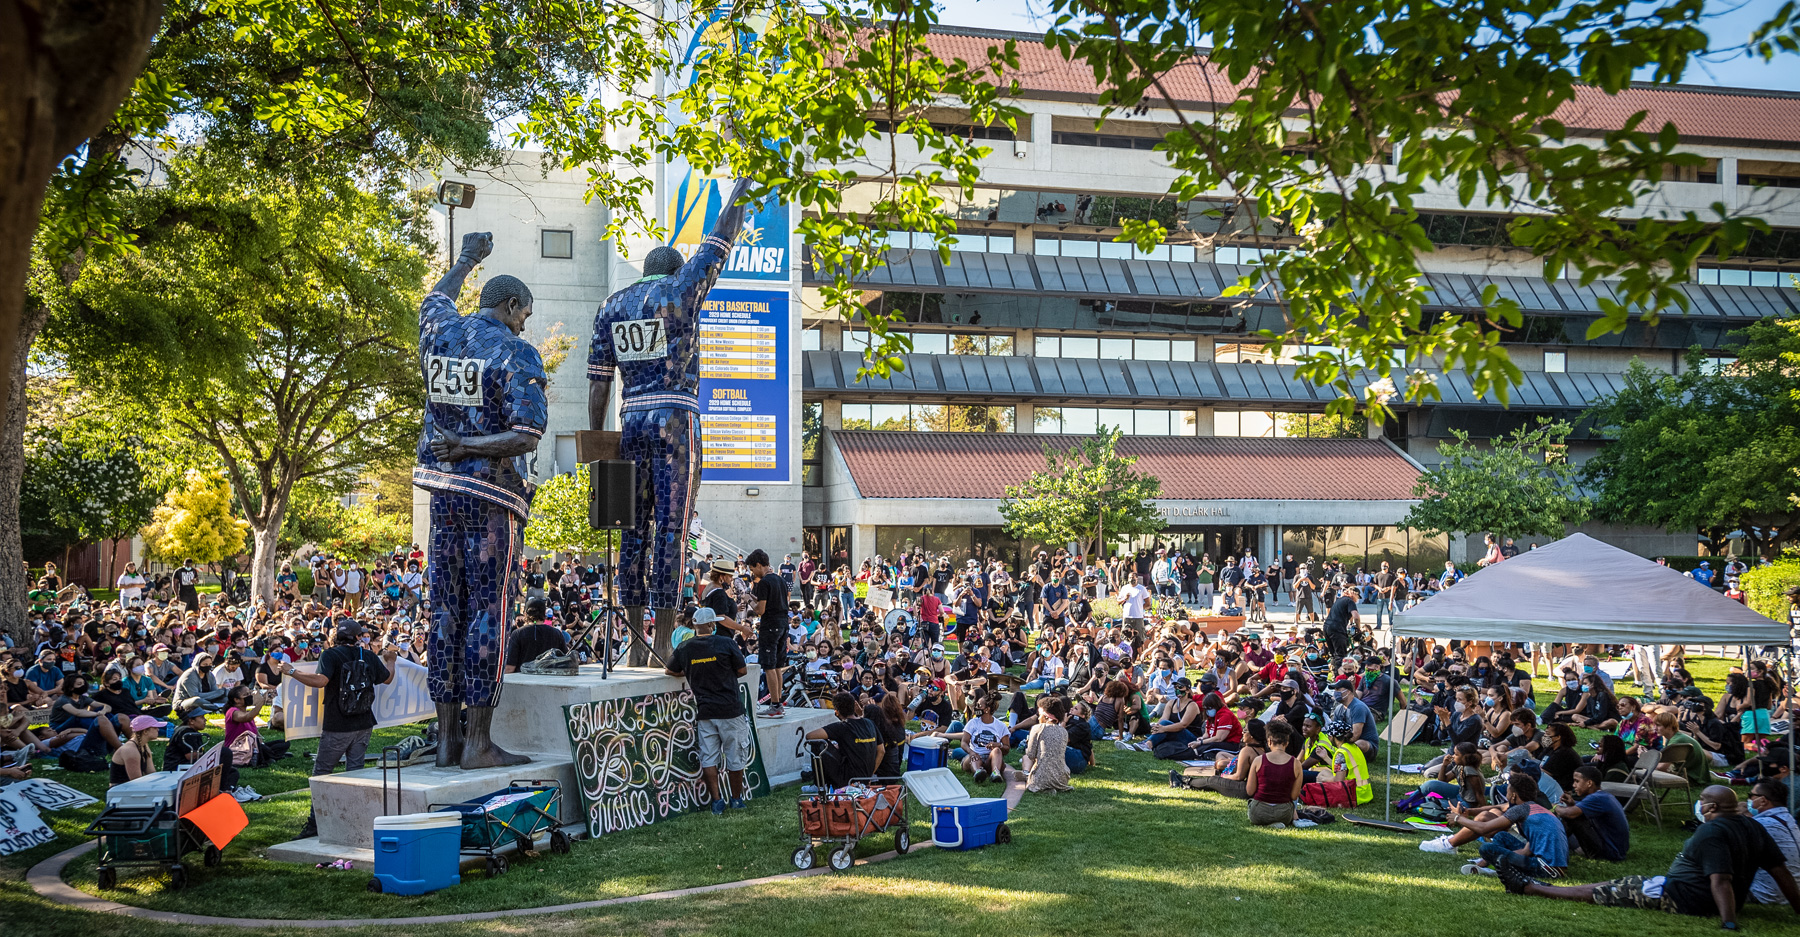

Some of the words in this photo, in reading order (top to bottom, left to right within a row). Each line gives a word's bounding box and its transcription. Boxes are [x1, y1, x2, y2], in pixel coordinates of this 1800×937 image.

[676, 243, 784, 273] SPTANS!
[726, 302, 770, 313] BASKETBALL
[615, 321, 660, 353] 307
[430, 359, 479, 396] 259
[712, 389, 747, 399] SOFTBALL
[1182, 507, 1208, 516] CLARK
[1211, 507, 1230, 516] HALL
[568, 698, 636, 741] Black
[635, 692, 698, 730] Lives
[796, 726, 804, 758] 2
[590, 790, 655, 838] Justice
[0, 826, 57, 852] JUSTICE
